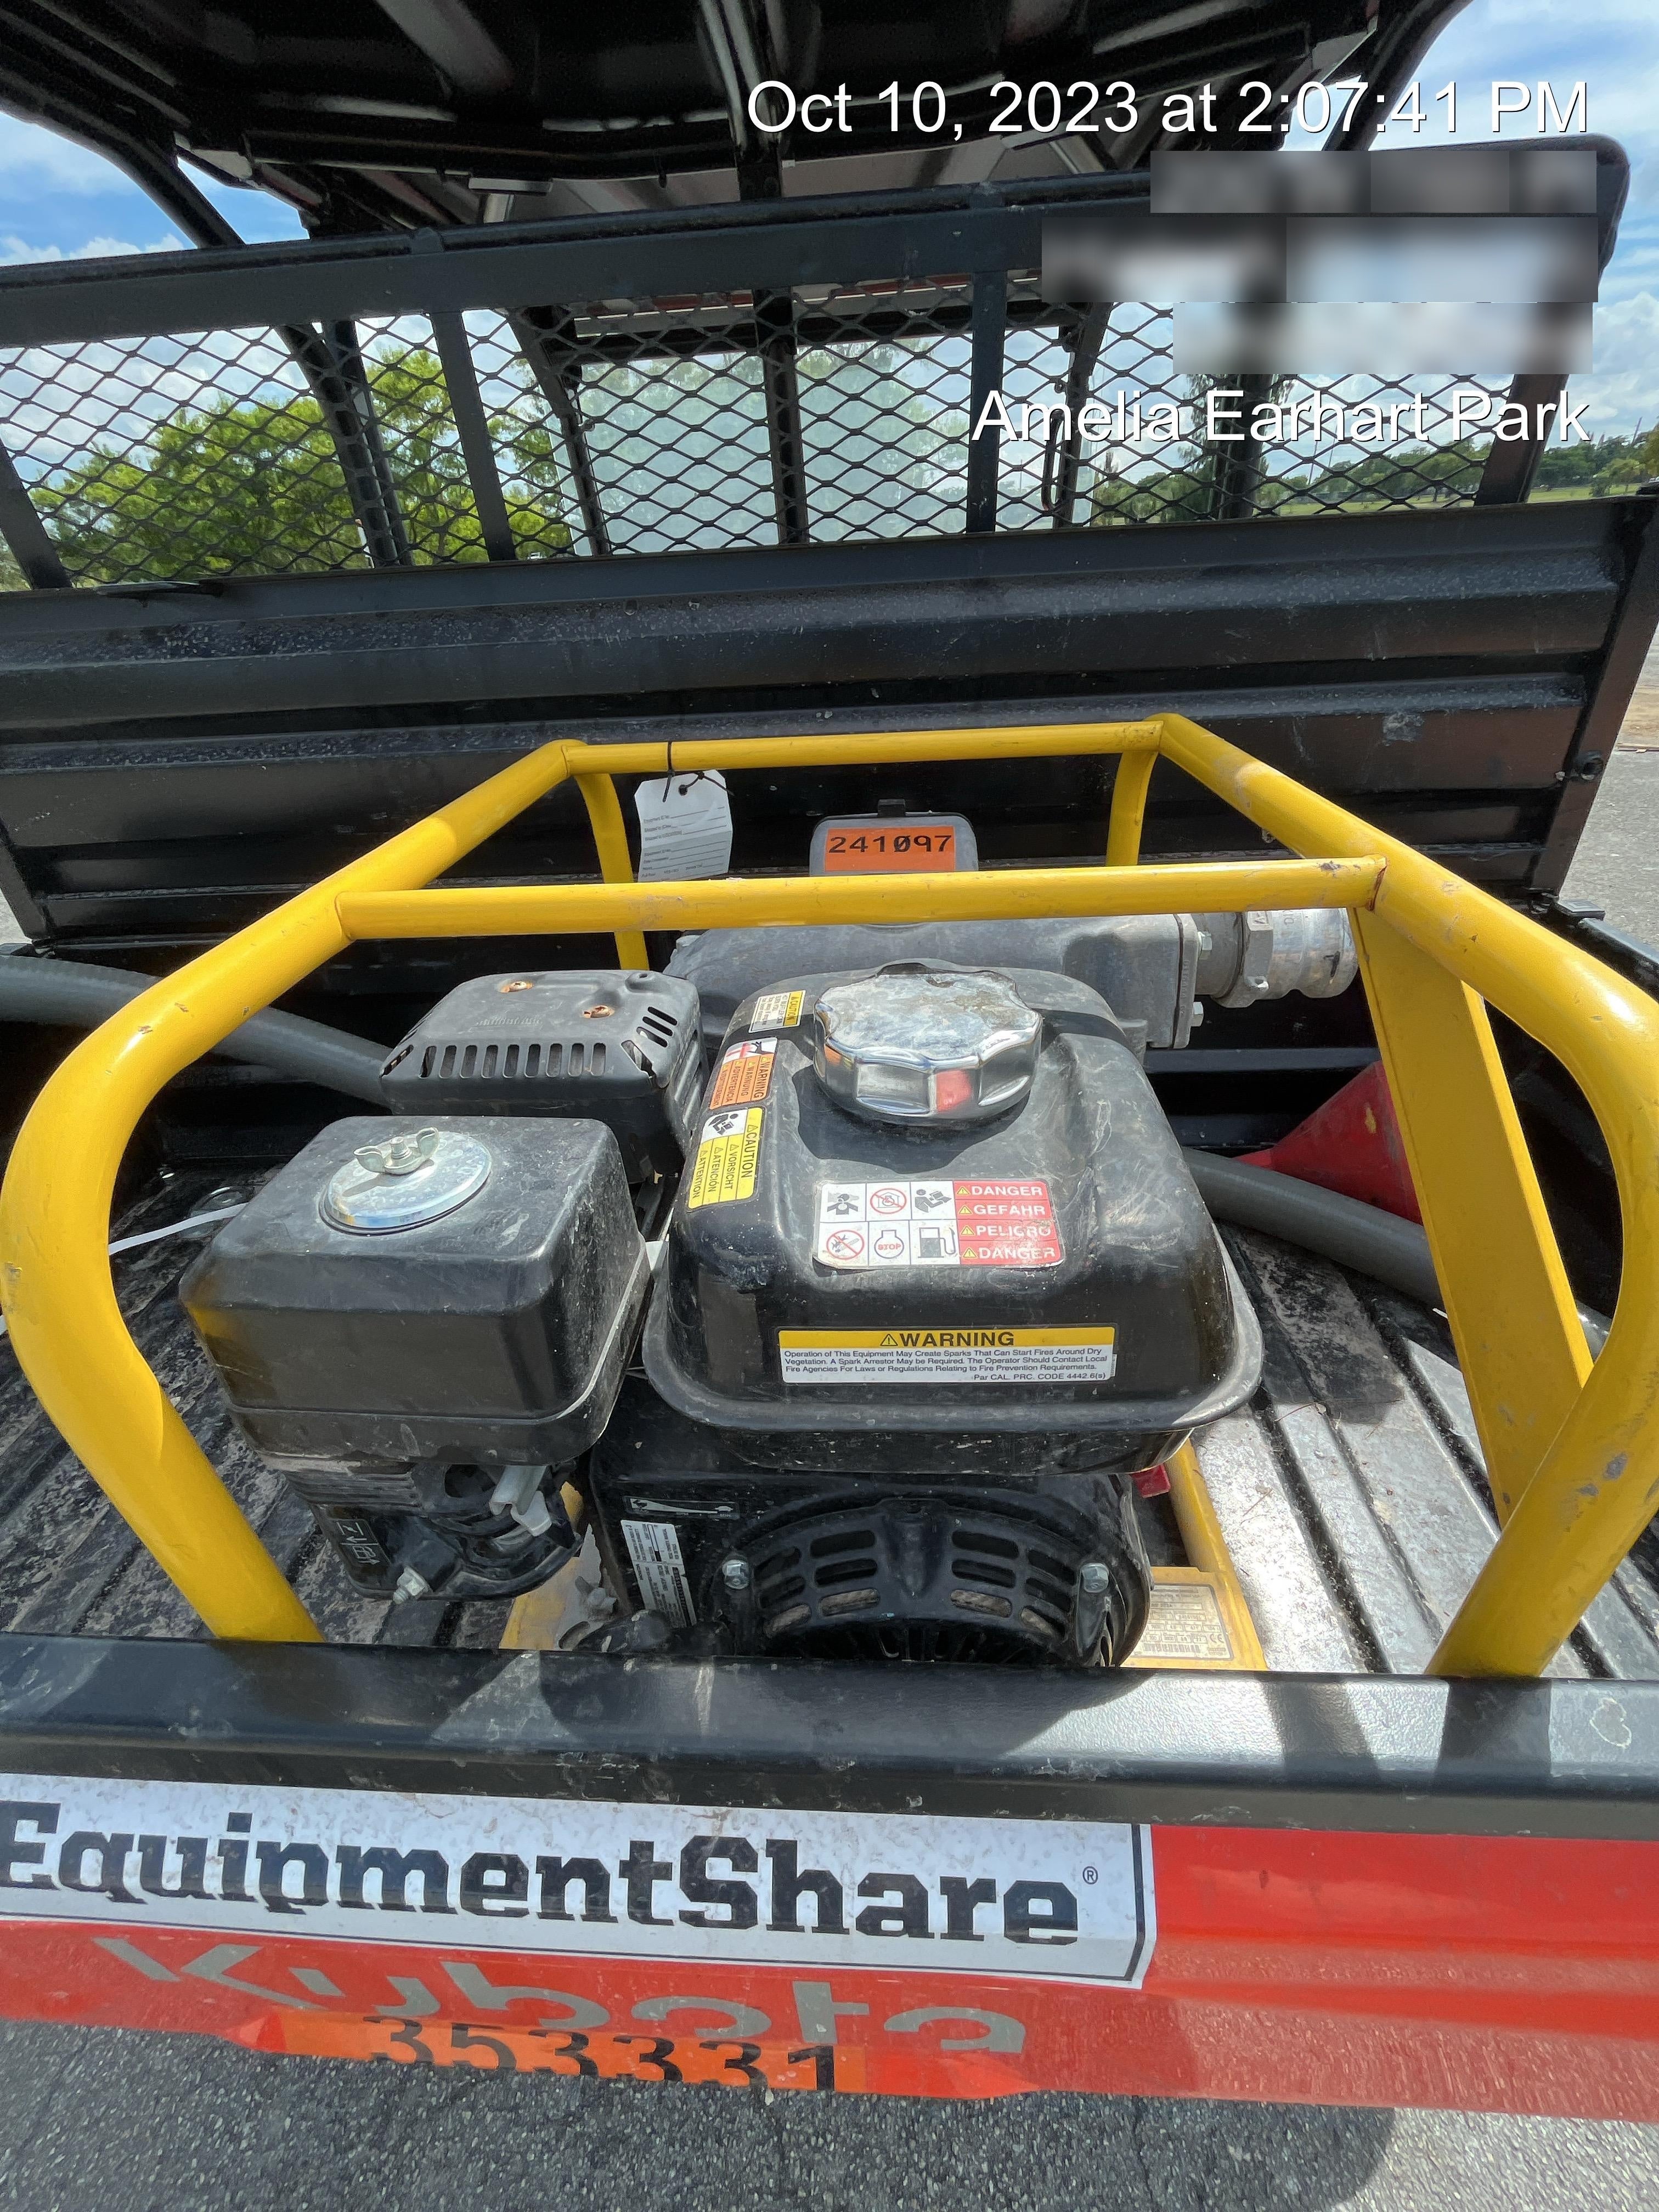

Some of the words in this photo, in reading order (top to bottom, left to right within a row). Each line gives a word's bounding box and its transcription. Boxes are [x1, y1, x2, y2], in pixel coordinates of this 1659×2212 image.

[828, 834, 952, 853] 241097
[725, 1065, 741, 1103] ADVERTENCIA
[741, 1065, 753, 1097] WARNUNG
[754, 1062, 771, 1098] WARNING
[724, 1152, 737, 1190] VORSICHT
[741, 1132, 757, 1178] CAUTION
[692, 1158, 706, 1199] ATTENTION
[708, 1155, 721, 1192] ATENCIÓN
[971, 1185, 1042, 1197] DANGER
[974, 1204, 1046, 1216] GEFAHR
[877, 1243, 902, 1251] STOP
[977, 1224, 1052, 1238] PELIGRO
[978, 1247, 1056, 1261] DANGER
[899, 1331, 1014, 1347] WARNING
[0, 1801, 1079, 1945] EquipmentShare
[363, 2016, 836, 2091] 353331
